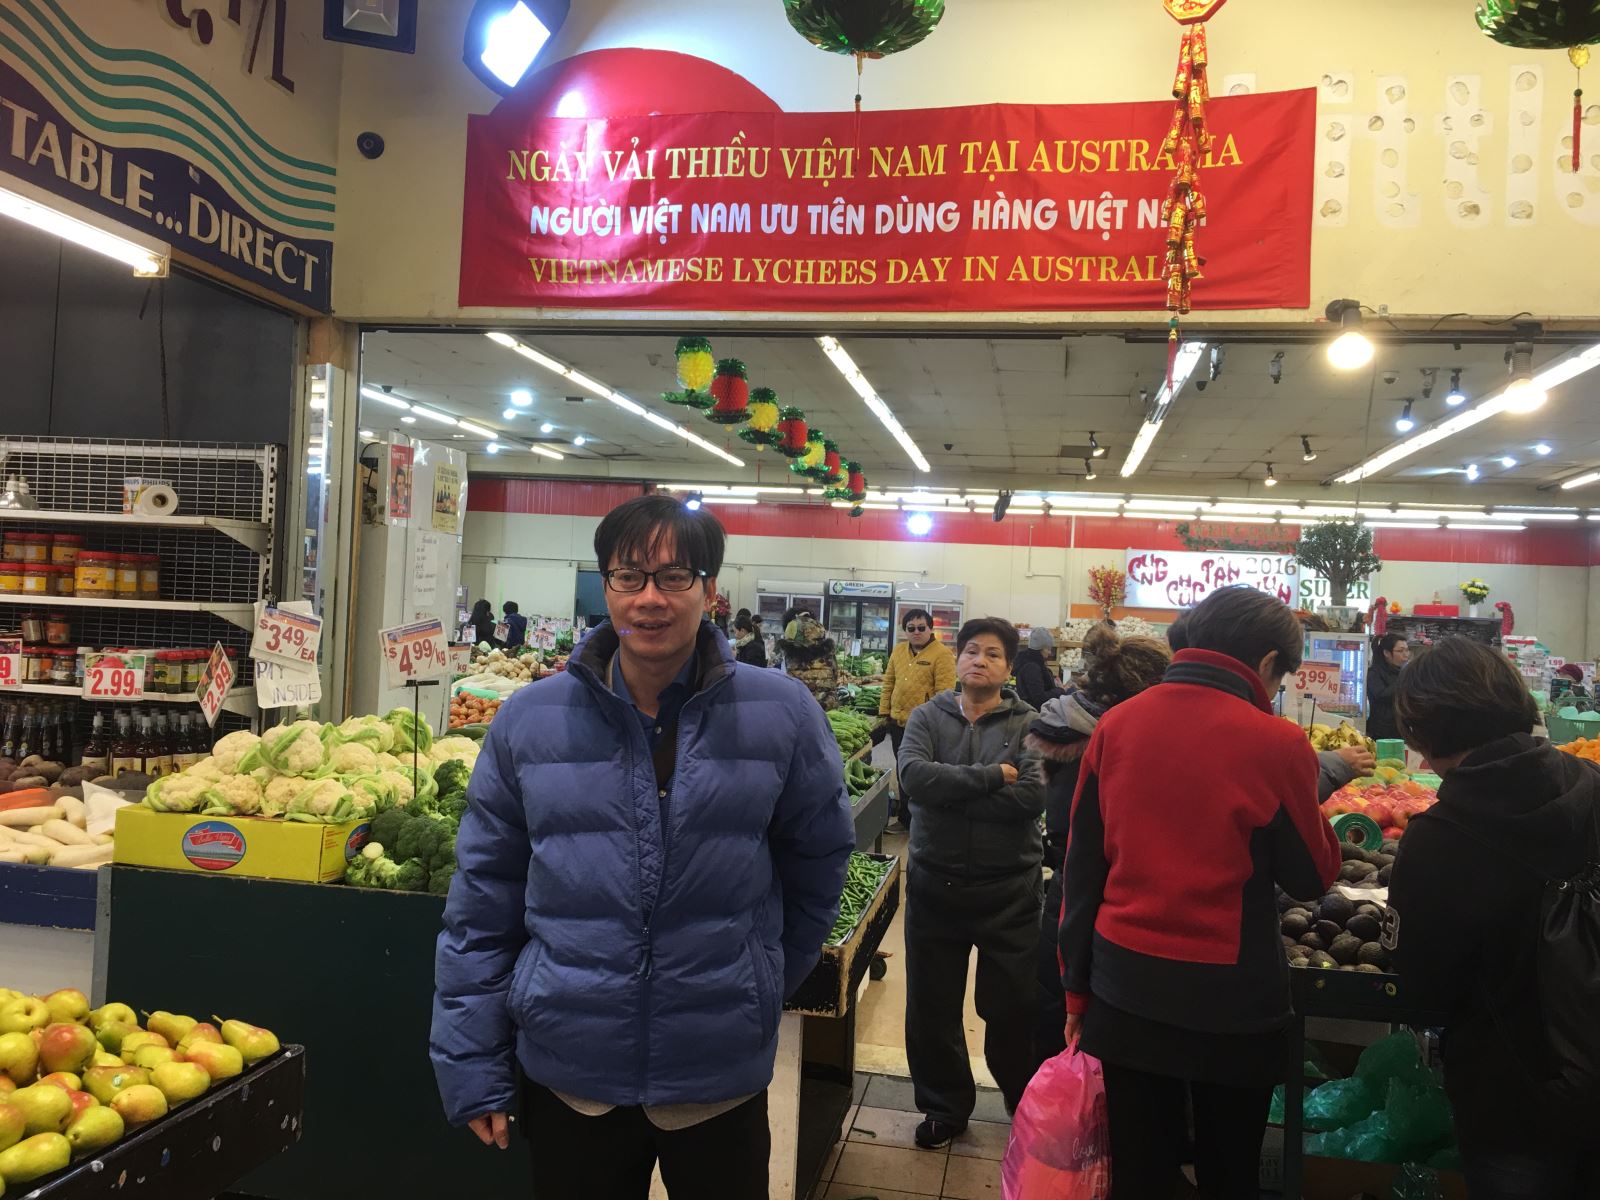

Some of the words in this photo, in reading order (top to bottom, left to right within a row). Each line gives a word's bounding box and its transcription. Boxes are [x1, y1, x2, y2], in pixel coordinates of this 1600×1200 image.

[506, 141, 595, 182] NGÀY
[602, 137, 656, 182] VẢI
[665, 131, 772, 180] THIỀU
[779, 137, 856, 187] VIỆT
[869, 143, 947, 178] NAM
[960, 140, 1019, 182] TẠI
[1029, 133, 1243, 174] AUSTRAIA
[530, 198, 621, 236] NGƯỜI
[630, 197, 682, 244] VIỆT
[691, 203, 751, 233] NAM
[761, 203, 797, 234] ƯU
[808, 197, 864, 234] TIÊN
[875, 195, 960, 234] DÙNG
[972, 191, 1058, 230] HÀNG
[1068, 191, 1128, 241] VIỆT
[188, 193, 318, 292] DIRECT
[528, 257, 723, 285] VIETNAMESE
[731, 259, 877, 284] LYCHEES
[886, 257, 953, 284] DAY
[962, 256, 998, 281] IN
[1006, 254, 1204, 282] AUSTRAL
[1246, 557, 1297, 575] 2016
[1300, 579, 1369, 598] SUER
[273, 682, 320, 704] INSIDE
